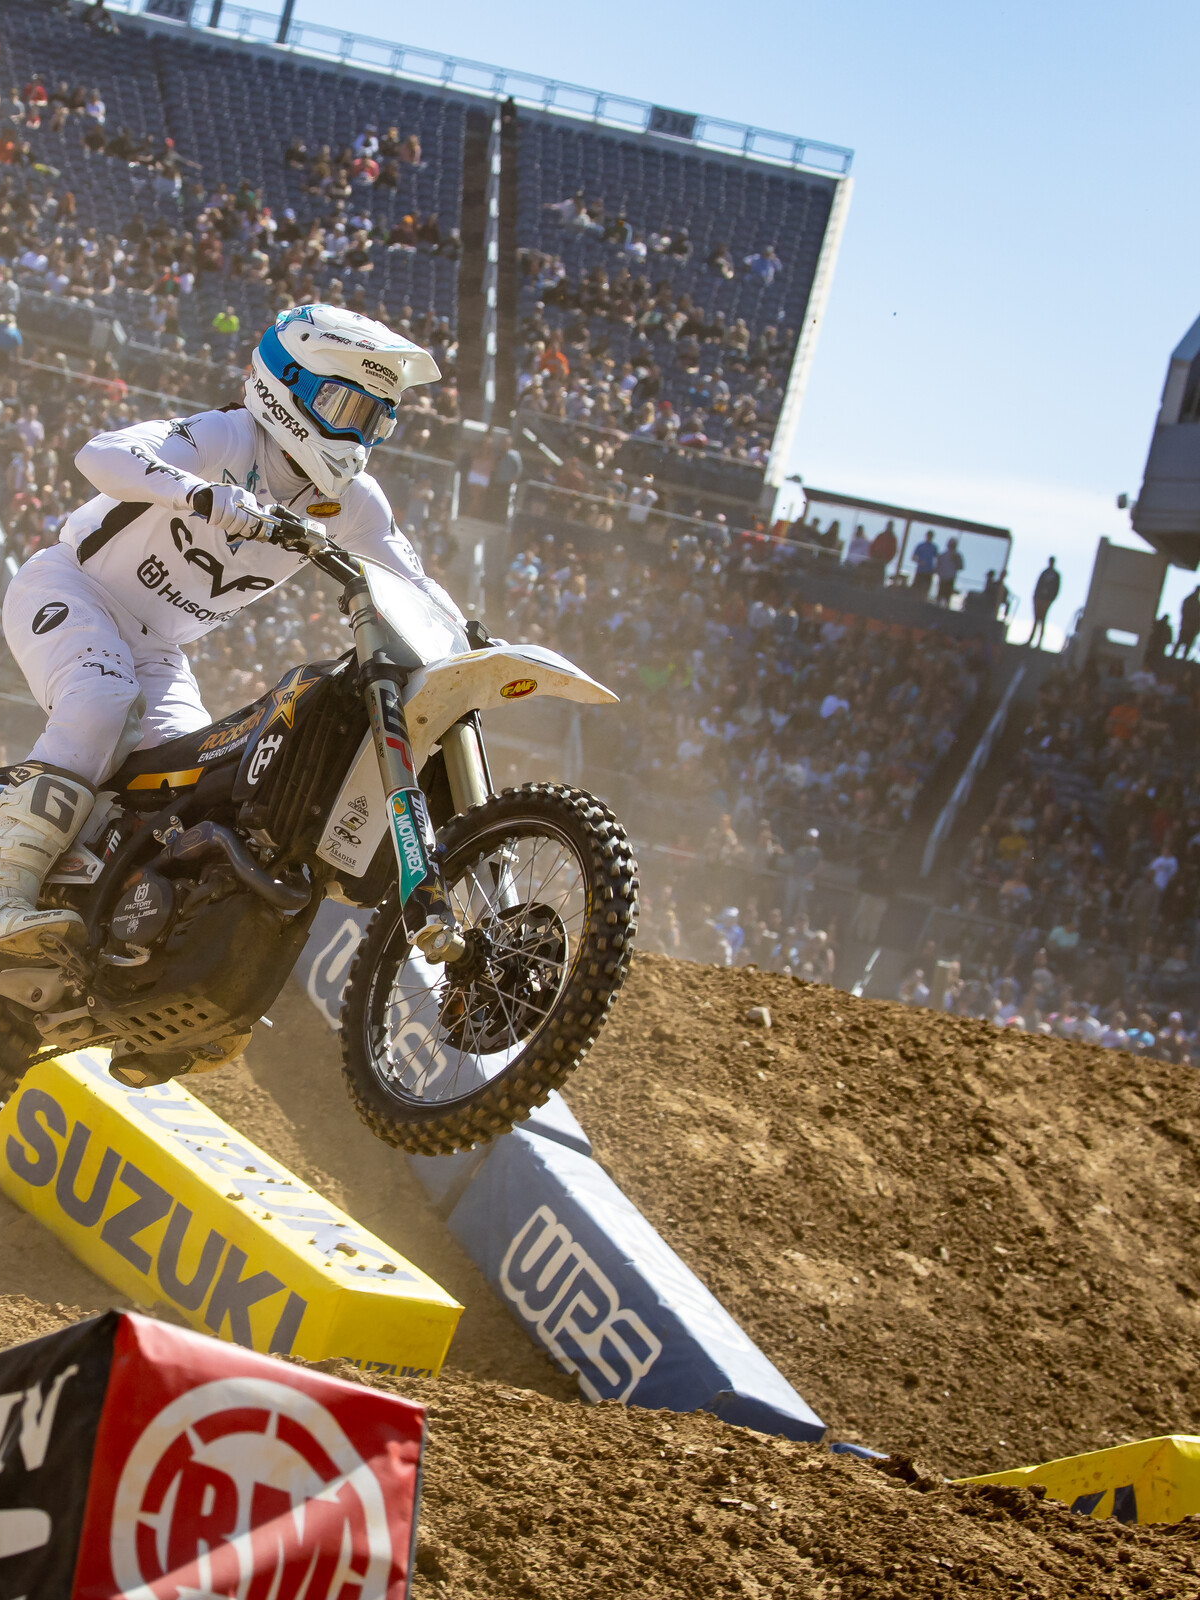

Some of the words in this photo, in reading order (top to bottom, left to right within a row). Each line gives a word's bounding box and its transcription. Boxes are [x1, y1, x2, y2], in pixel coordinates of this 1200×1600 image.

[361, 358, 398, 383] ROCKSTAR
[254, 378, 309, 442] ROCKSTAR
[501, 681, 536, 697] FMF
[198, 707, 266, 752] ROCKSTAR
[198, 742, 228, 763] ENERGY
[30, 776, 78, 834] G
[325, 836, 357, 866] PARADISE
[396, 814, 424, 877] MOTOREX
[125, 900, 152, 911] FACTORY
[6, 1088, 308, 1355] SUZUKI
[501, 1205, 662, 1404] WPS
[158, 1461, 354, 1600] RM
